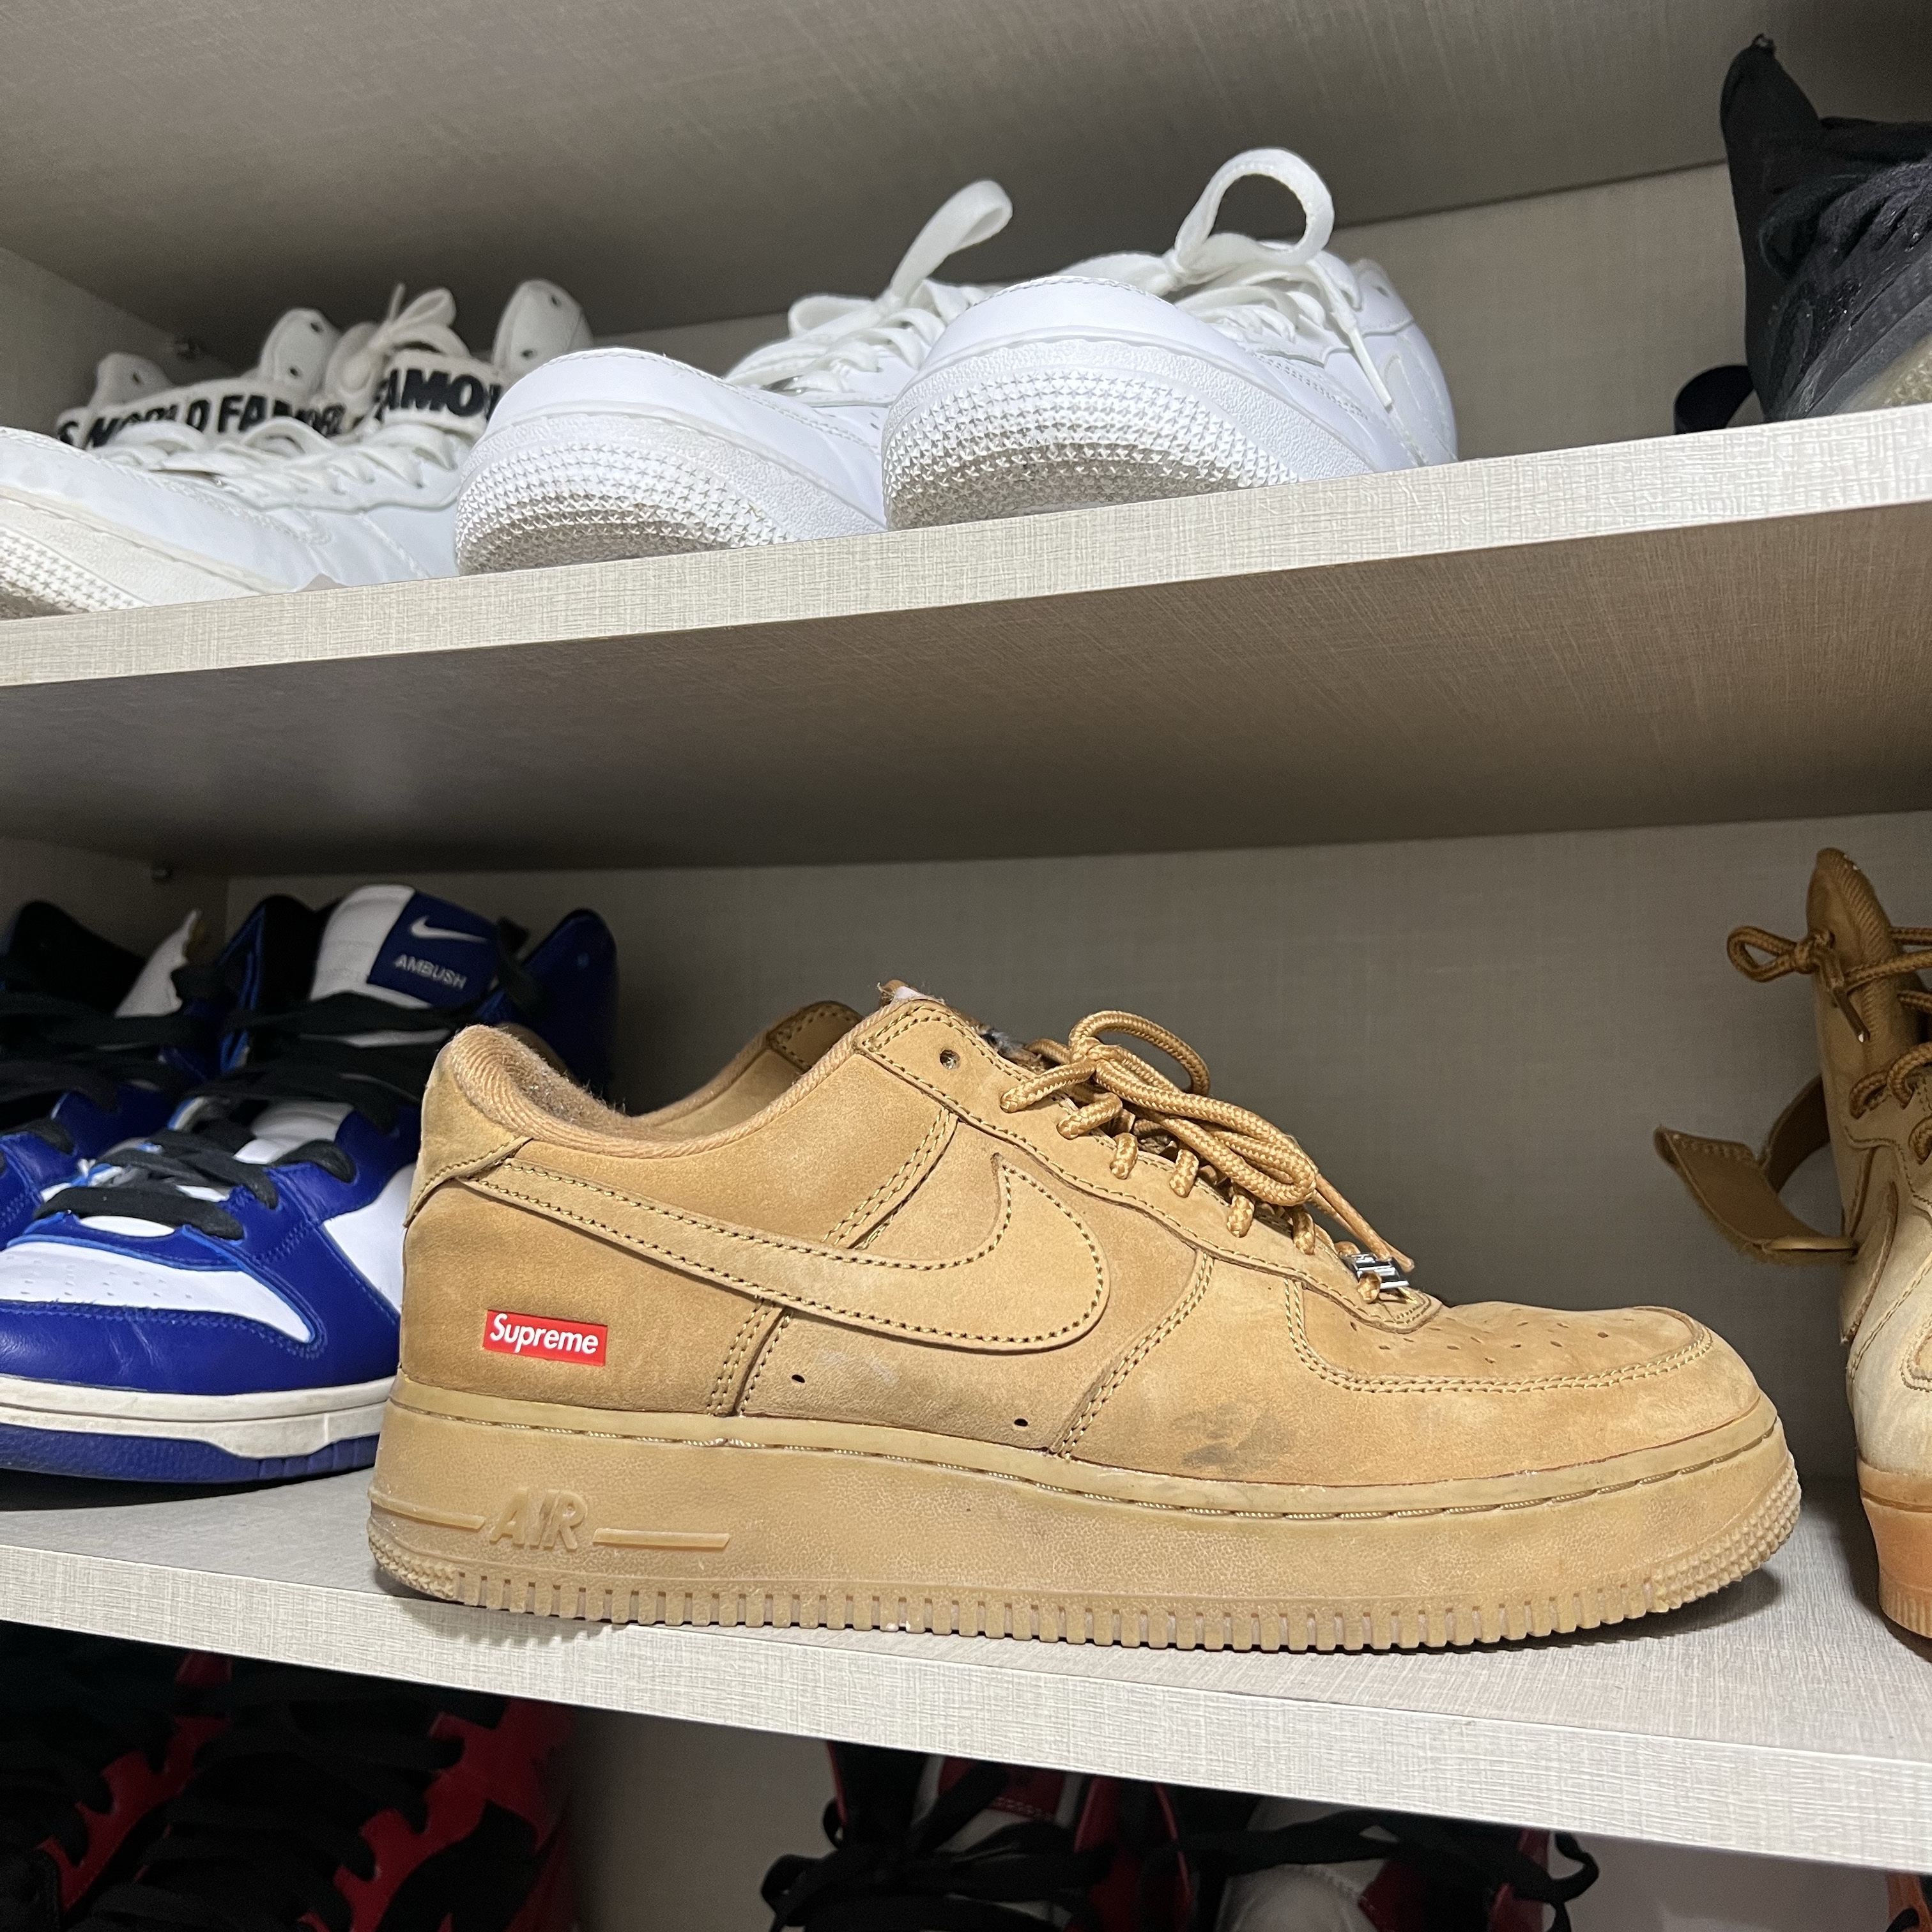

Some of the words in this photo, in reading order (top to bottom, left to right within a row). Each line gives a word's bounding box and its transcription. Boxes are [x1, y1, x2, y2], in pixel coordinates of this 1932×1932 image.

[394, 954, 467, 990] AMBUSH
[490, 1313, 599, 1354] Supreme
[489, 1487, 588, 1550] AIR
